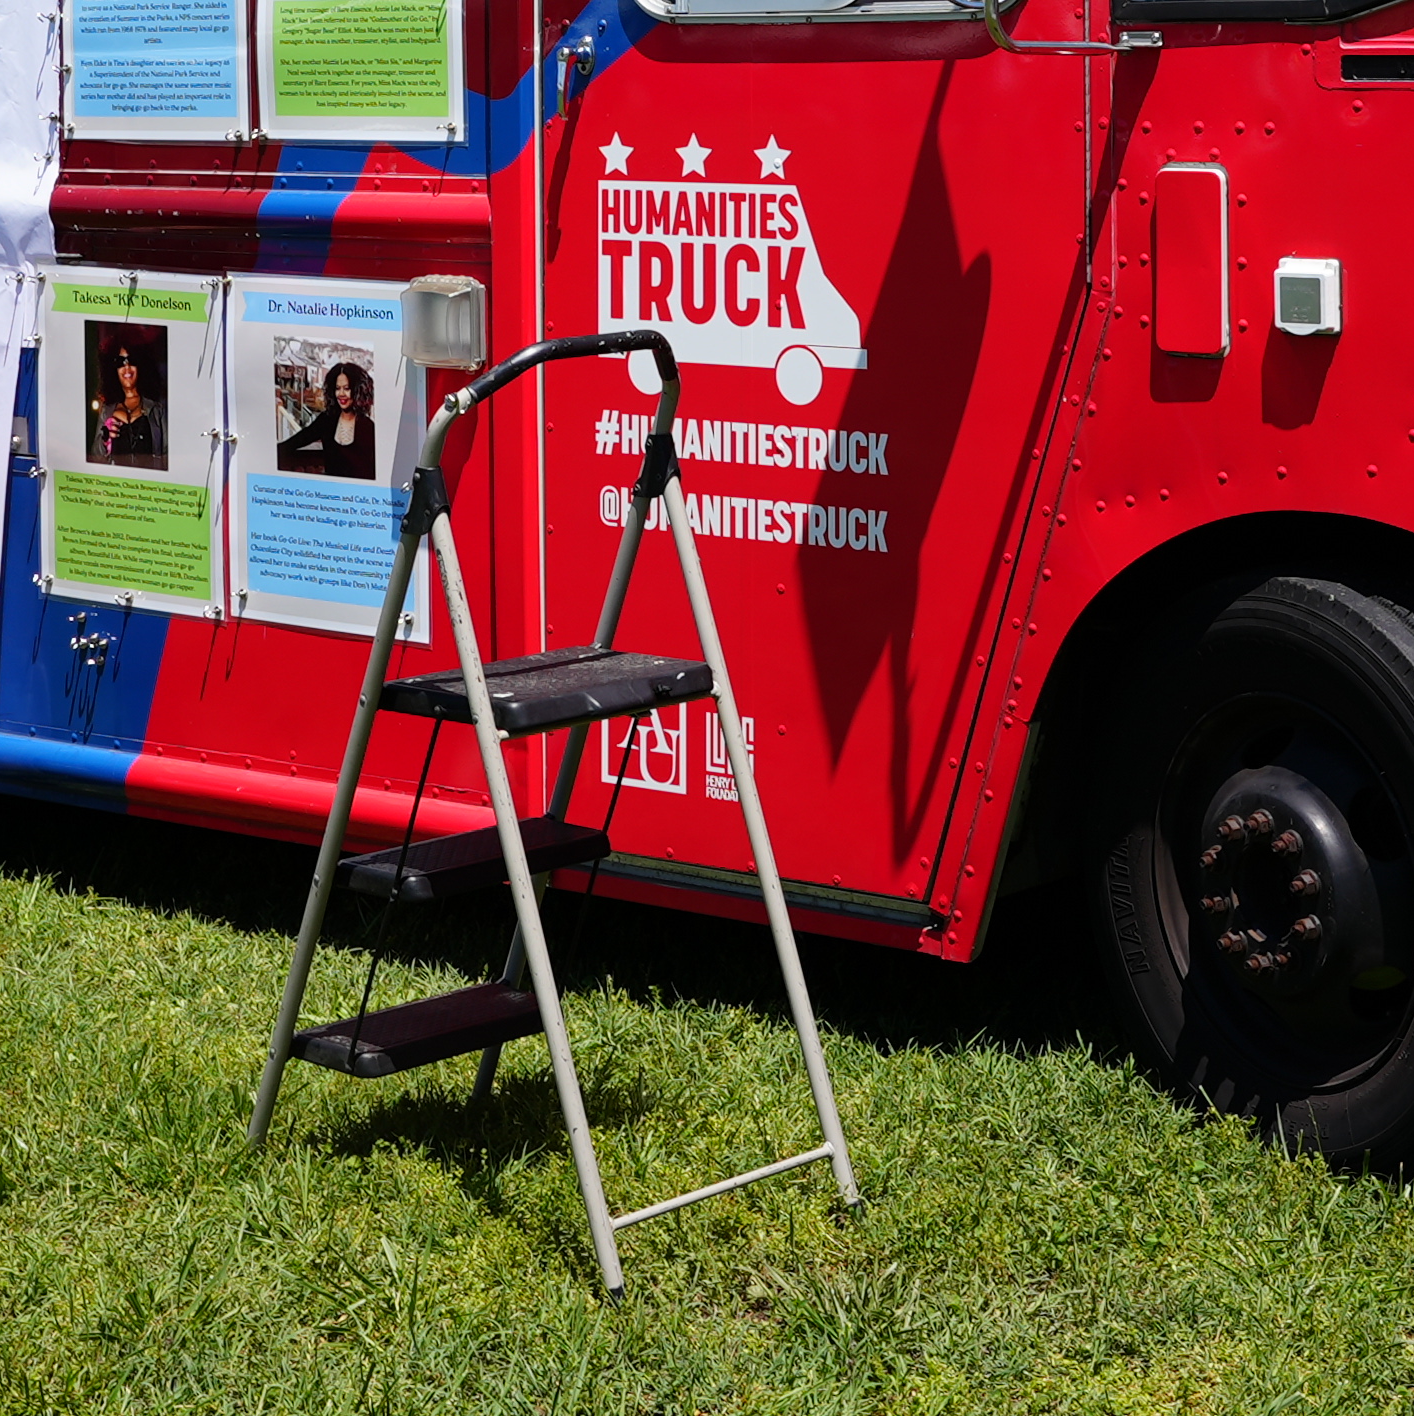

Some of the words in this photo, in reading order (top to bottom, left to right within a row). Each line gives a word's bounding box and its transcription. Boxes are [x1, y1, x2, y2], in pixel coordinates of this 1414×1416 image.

[601, 188, 799, 241] HUMANITIES
[601, 239, 807, 330] TRUCK
[72, 290, 111, 305] Takesa
[141, 295, 192, 311] Donelson
[268, 299, 286, 314] Dr.
[287, 300, 328, 316] Natalie
[330, 303, 394, 321] Hopkinson
[269, 510, 280, 518] her
[315, 515, 338, 526] leading
